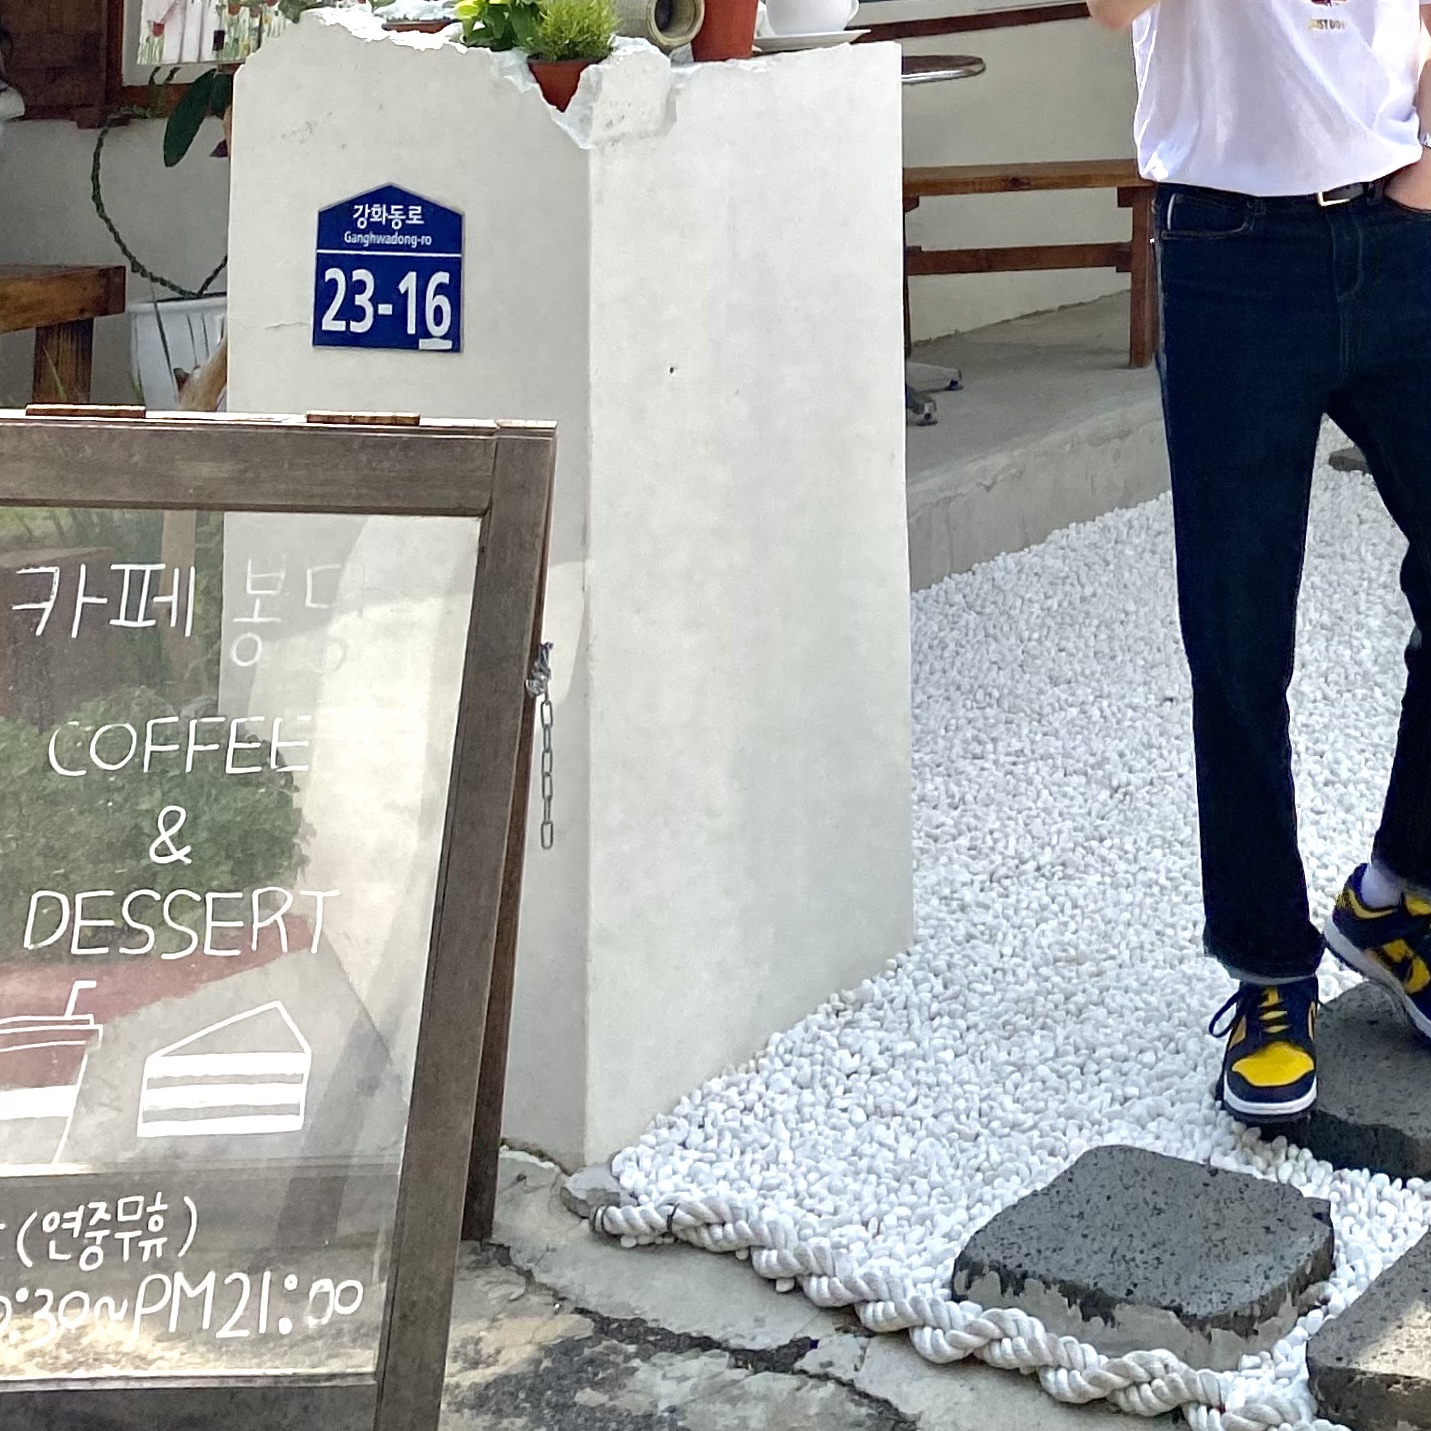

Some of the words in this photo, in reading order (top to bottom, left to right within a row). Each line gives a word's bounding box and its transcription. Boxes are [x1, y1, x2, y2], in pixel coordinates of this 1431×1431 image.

[344, 230, 432, 249] Ganghwadong-ro
[353, 204, 424, 229] 강화동로
[322, 268, 451, 337] 23-16
[12, 564, 196, 638] 카페
[48, 715, 312, 776] COFFEE
[149, 805, 192, 864] &
[23, 886, 341, 960] DESSERT
[17, 1192, 198, 1270] (연중무휴)
